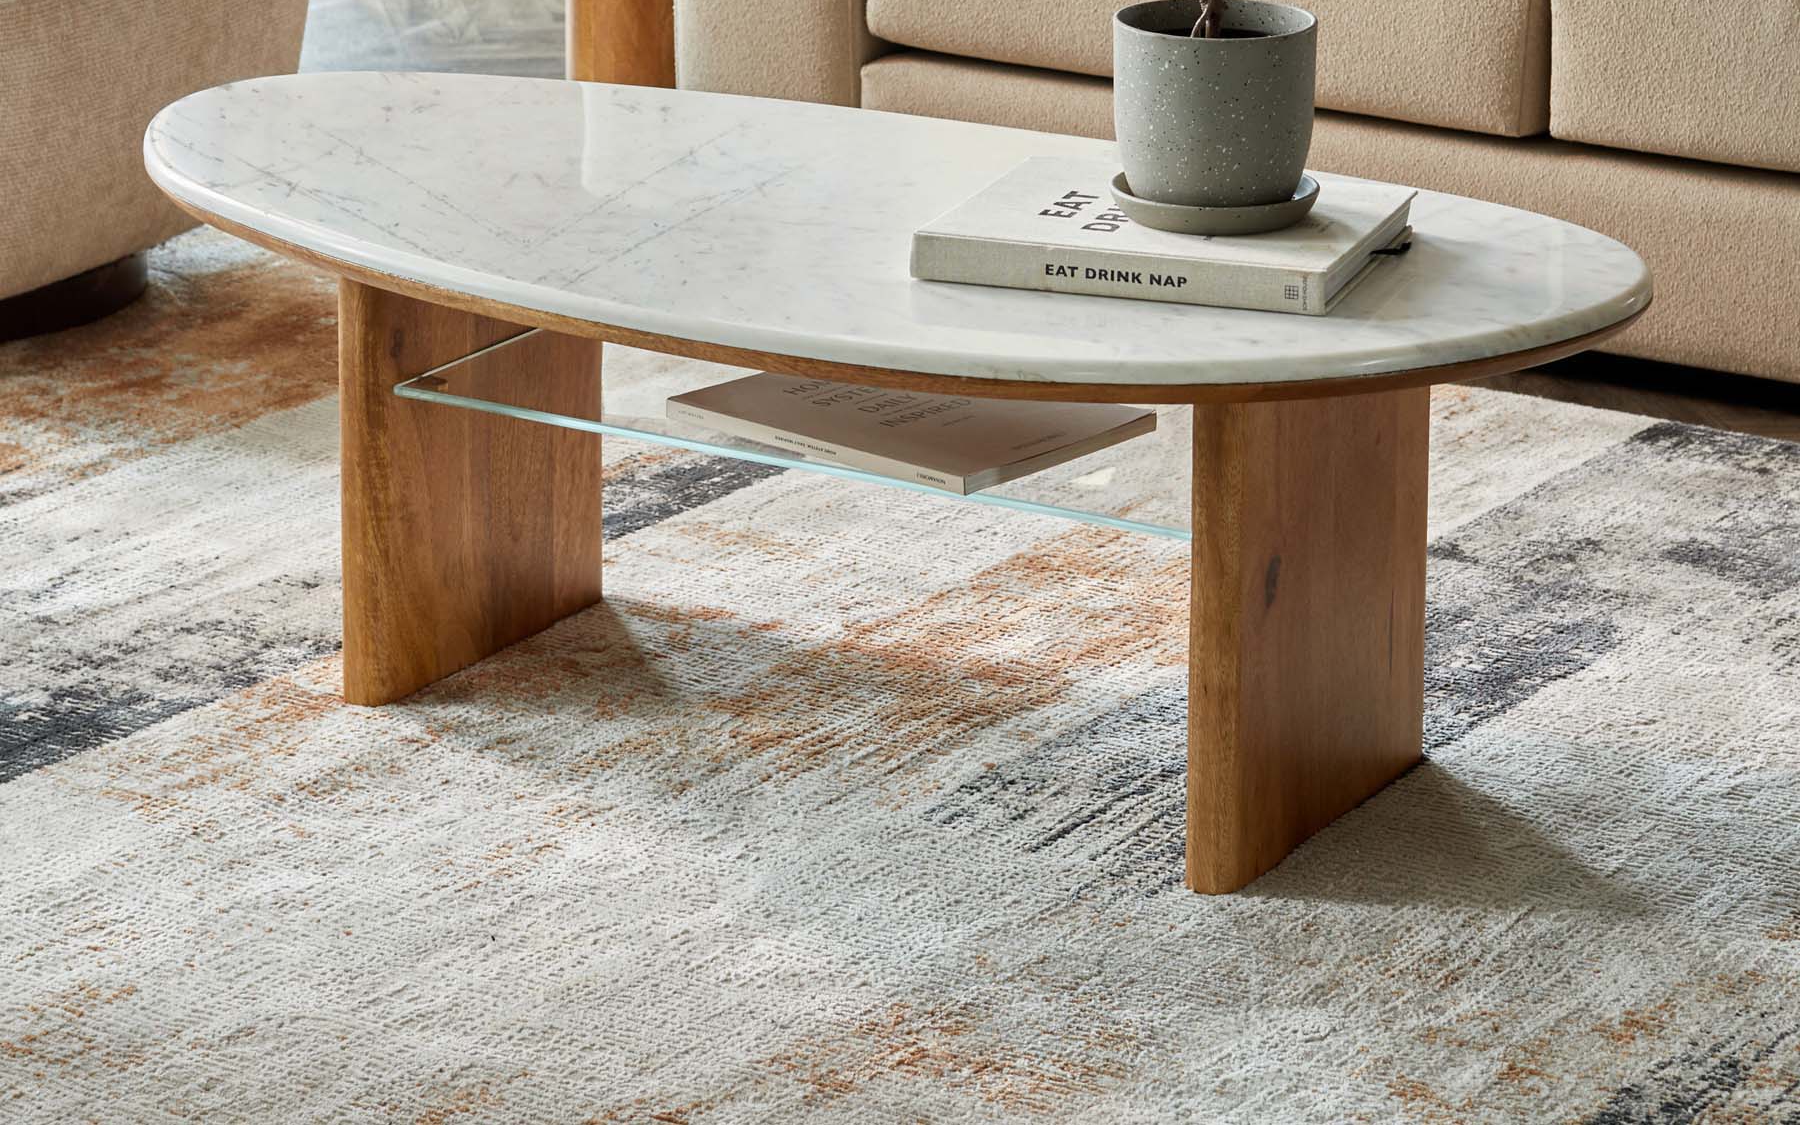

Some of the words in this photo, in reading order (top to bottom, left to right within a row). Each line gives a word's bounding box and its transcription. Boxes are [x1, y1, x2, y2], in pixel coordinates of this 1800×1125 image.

[1038, 191, 1100, 218] EAT
[1045, 264, 1078, 278] EAT
[1085, 268, 1142, 285] DRINK
[1149, 274, 1187, 288] NAP
